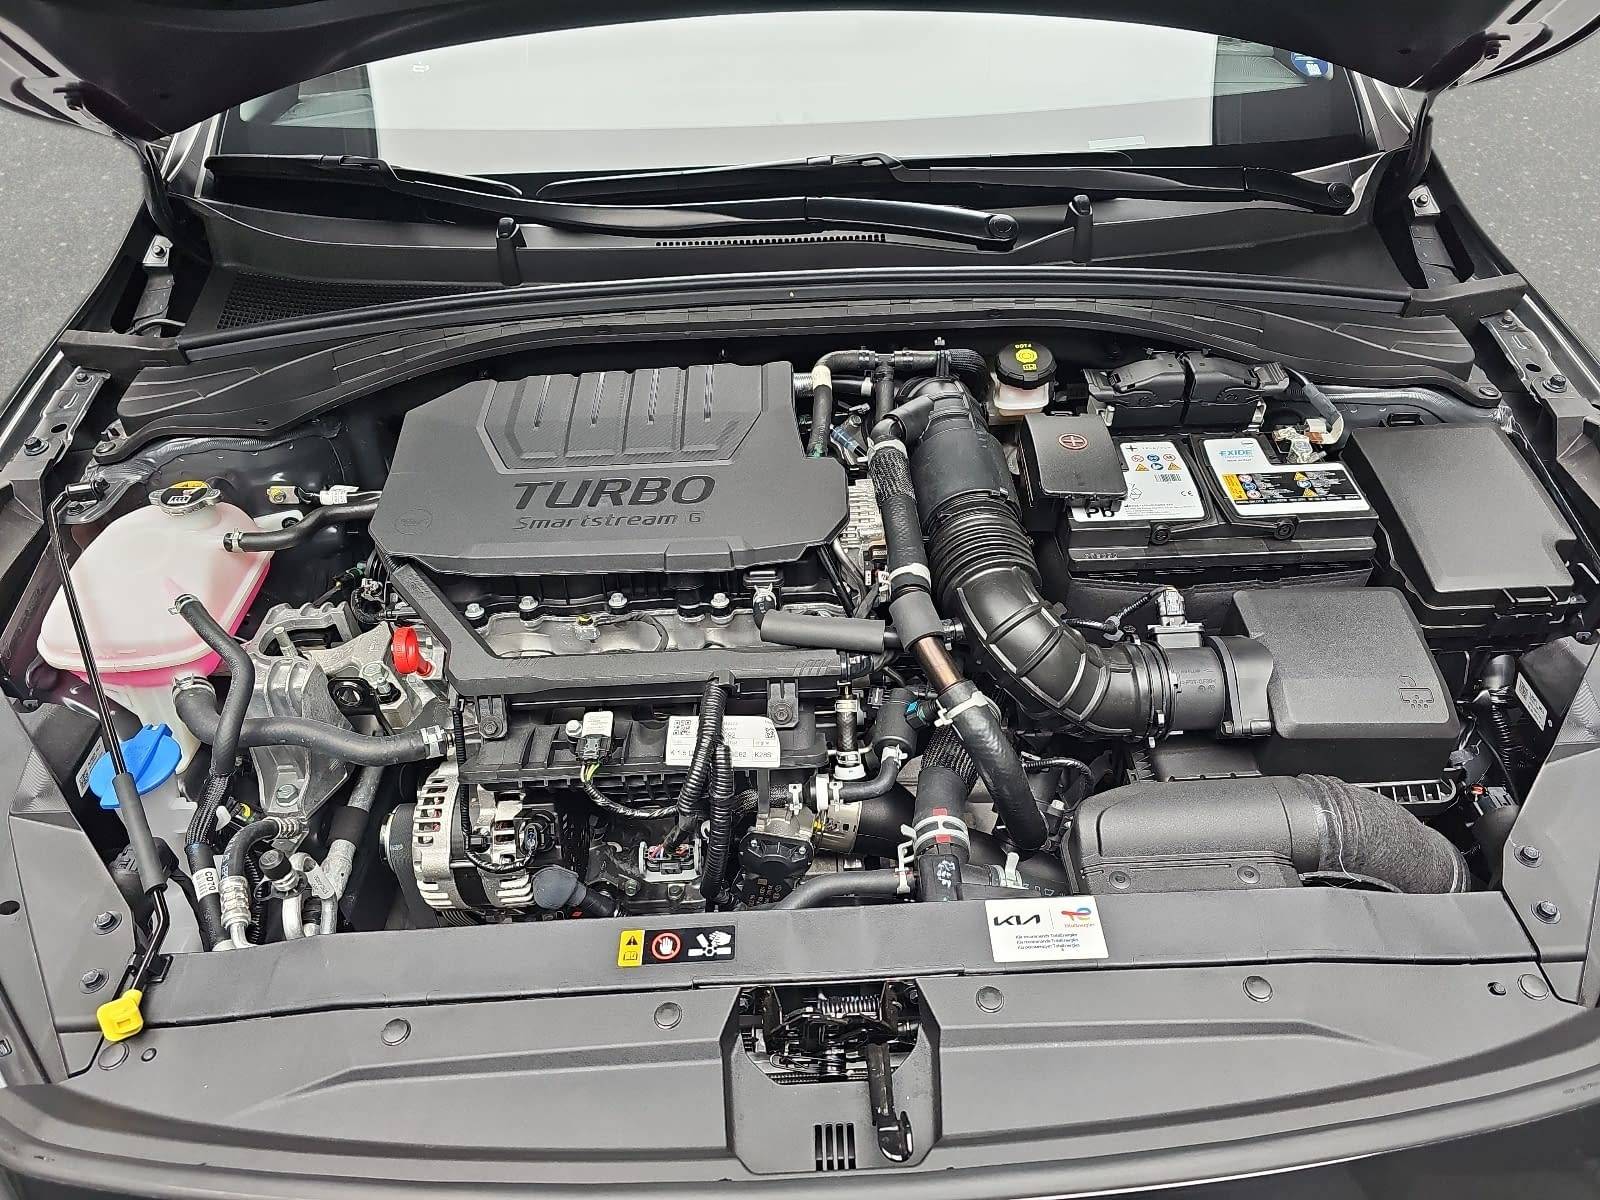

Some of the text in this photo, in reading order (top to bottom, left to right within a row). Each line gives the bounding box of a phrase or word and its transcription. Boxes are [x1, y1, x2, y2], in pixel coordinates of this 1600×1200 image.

[1218, 449, 1253, 457] EXIDE
[513, 474, 716, 510] TURBO
[512, 511, 702, 530] Smartstream G
[993, 914, 1041, 926] KIA
